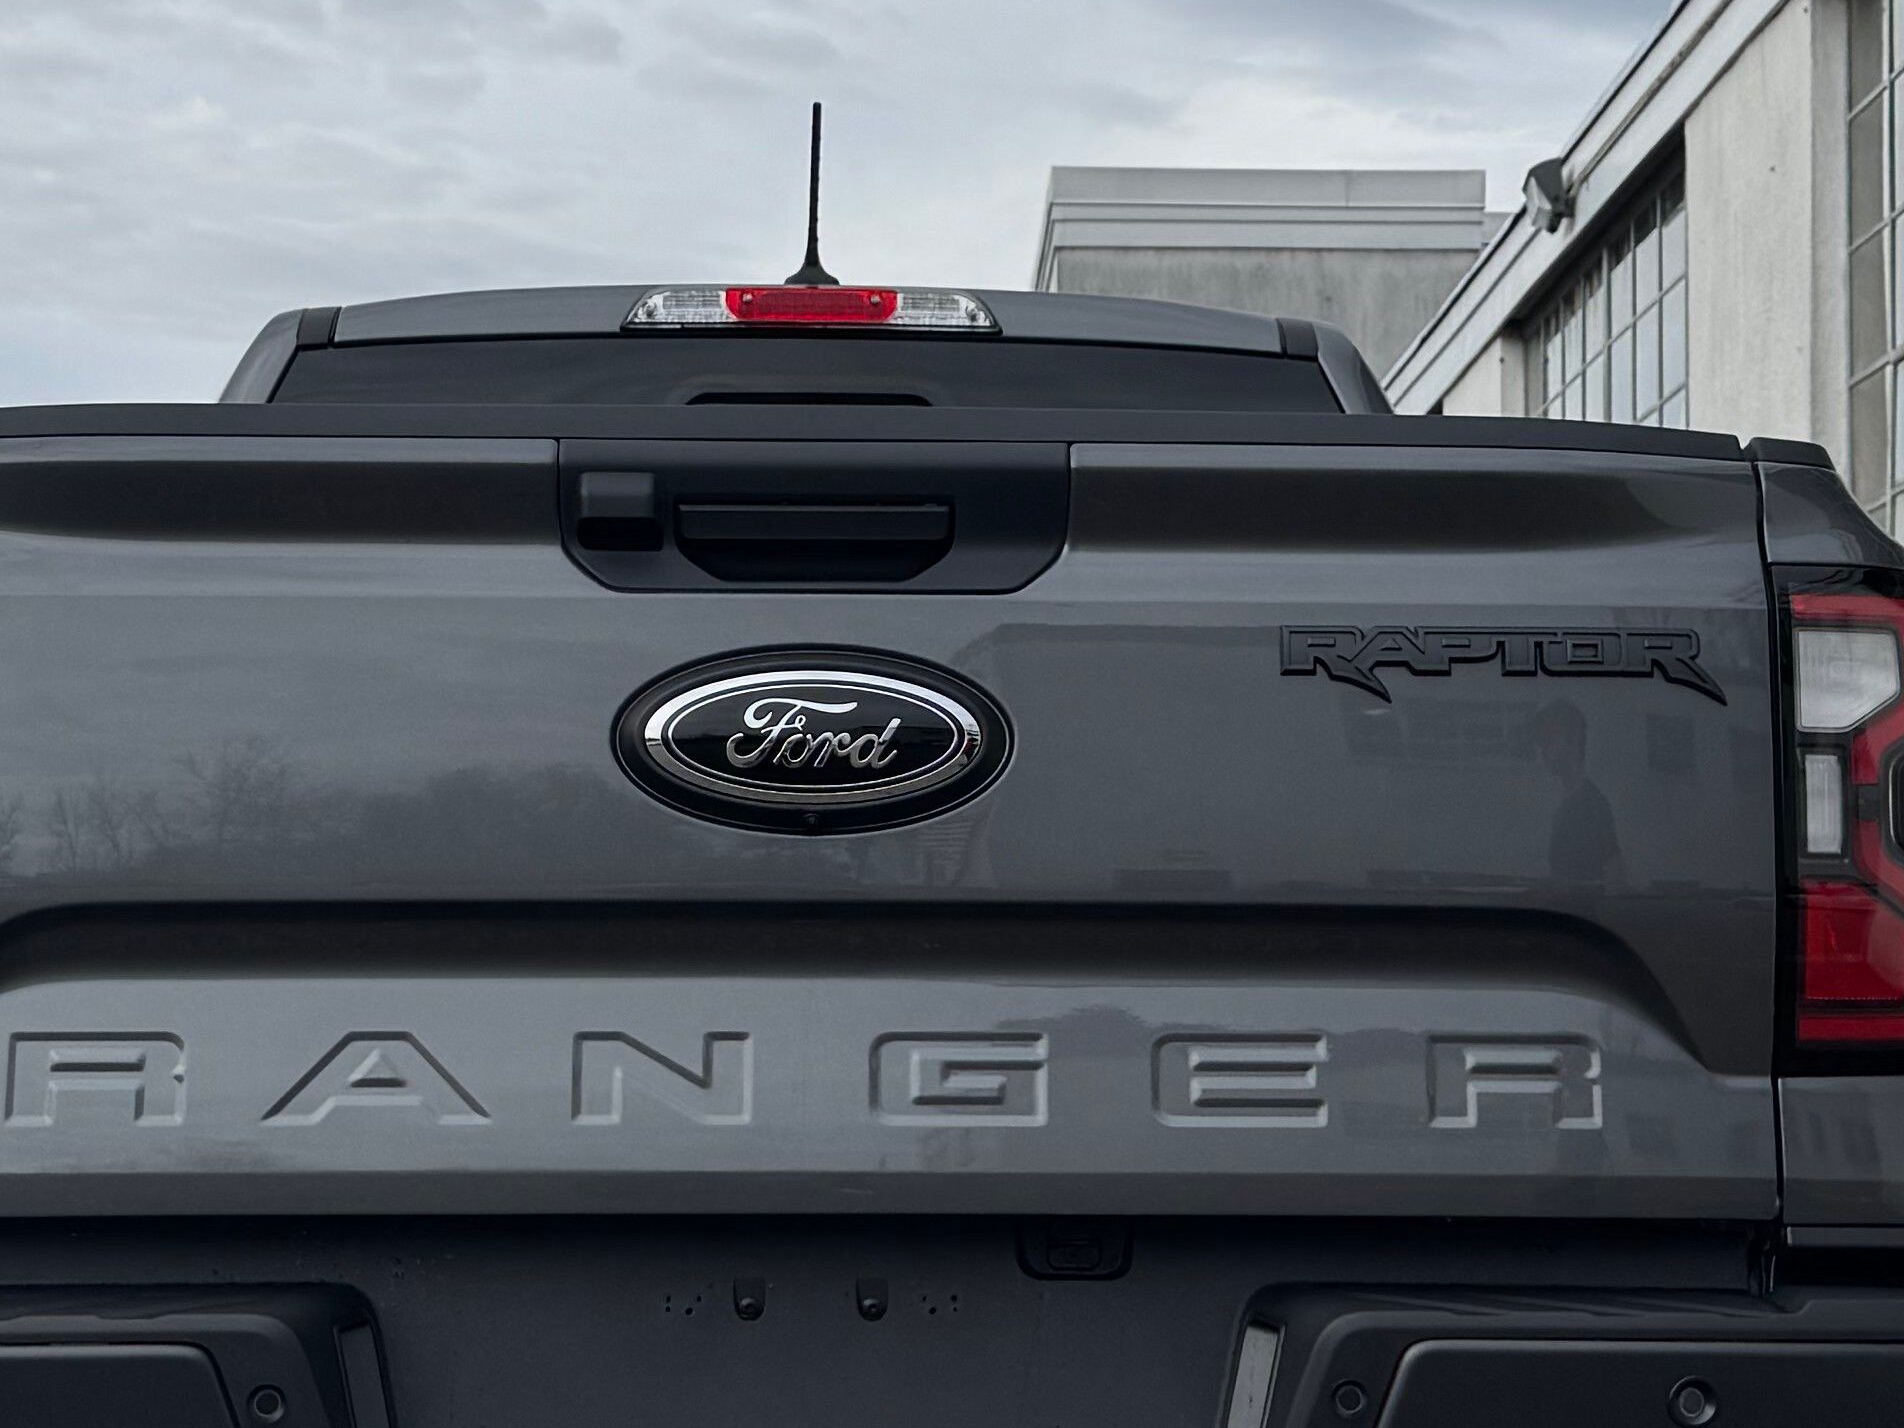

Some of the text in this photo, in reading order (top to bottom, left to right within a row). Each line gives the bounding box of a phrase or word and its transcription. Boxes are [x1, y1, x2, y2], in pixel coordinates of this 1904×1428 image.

[1279, 625, 1728, 706] RAPTOR
[726, 698, 901, 768] Ford
[4, 1030, 1603, 1129] RANGER
